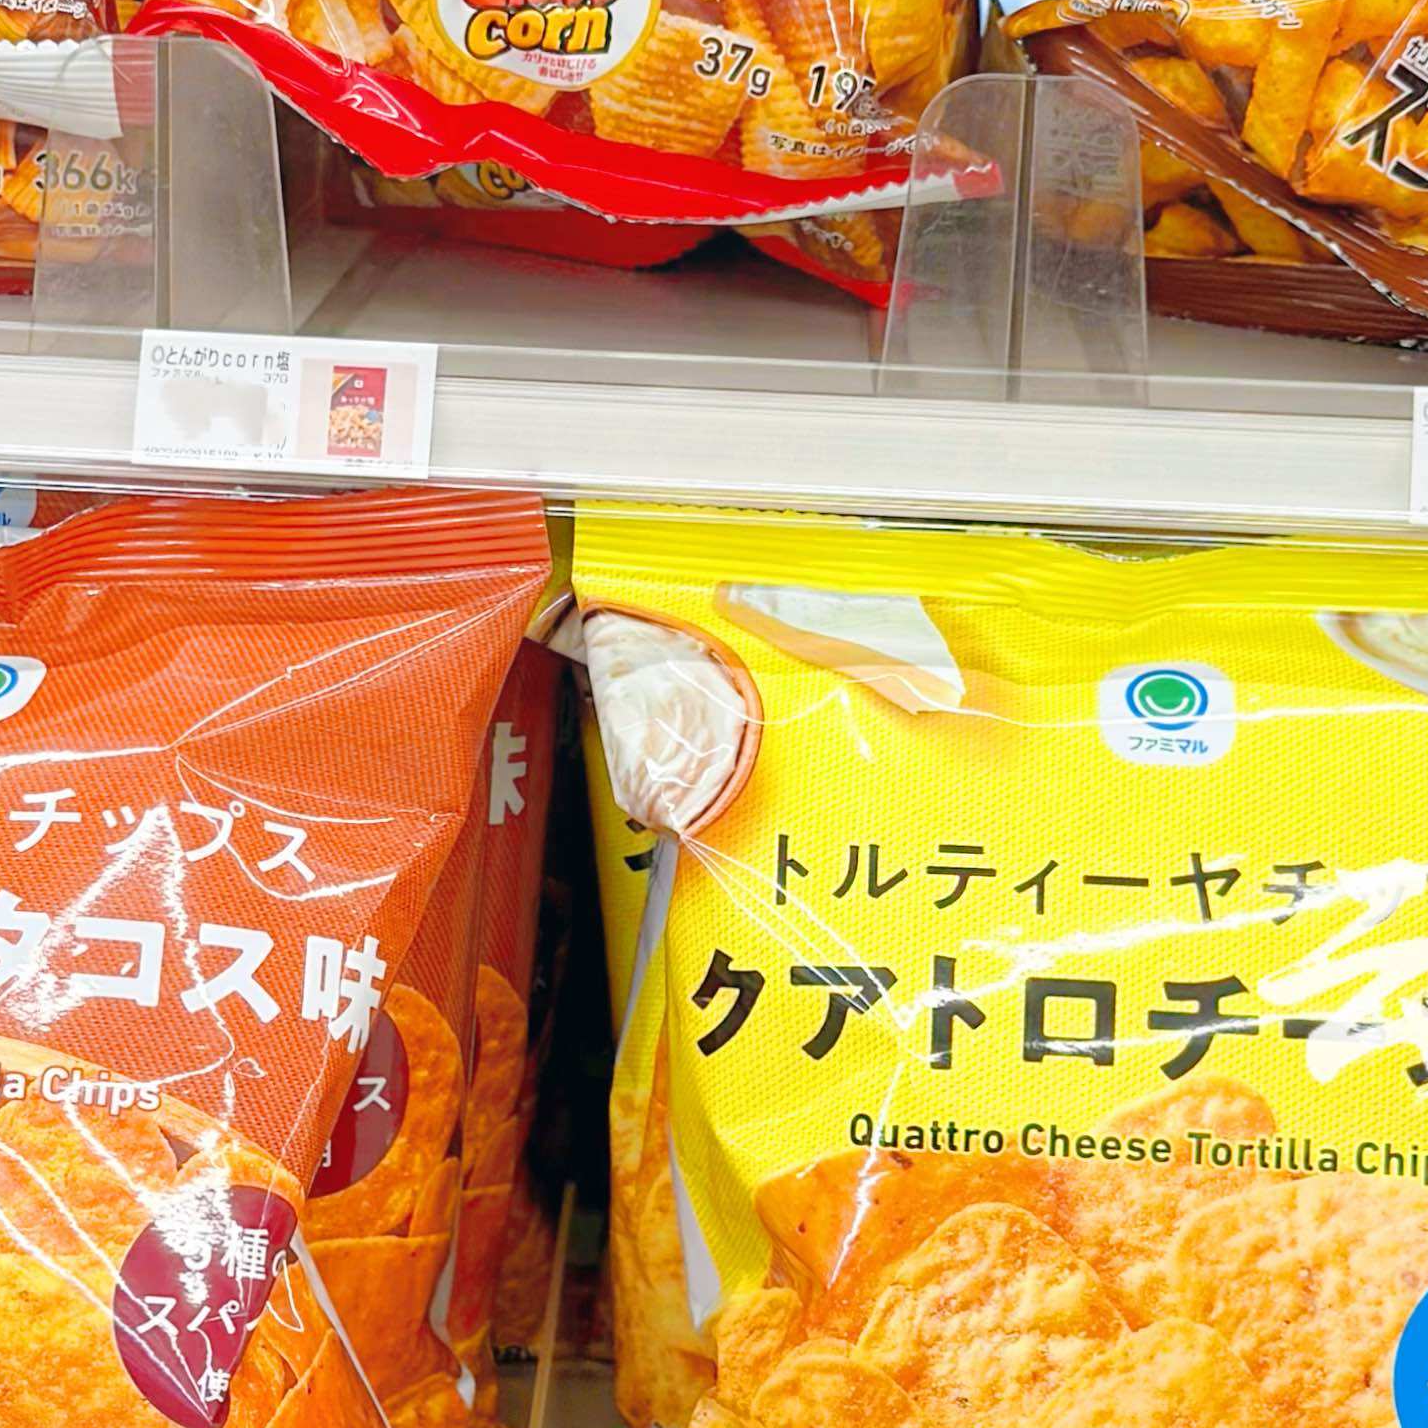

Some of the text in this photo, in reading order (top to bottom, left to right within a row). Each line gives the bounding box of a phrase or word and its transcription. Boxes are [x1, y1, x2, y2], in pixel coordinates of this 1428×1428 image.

[464, 5, 613, 60] corn
[695, 36, 772, 98] 37g
[1127, 732, 1209, 757] ファミマル
[35, 1061, 162, 1118] Chips
[848, 1112, 1007, 1164] Quattro
[1020, 1119, 1174, 1168] Cheese
[1185, 1127, 1342, 1175] Tortilla
